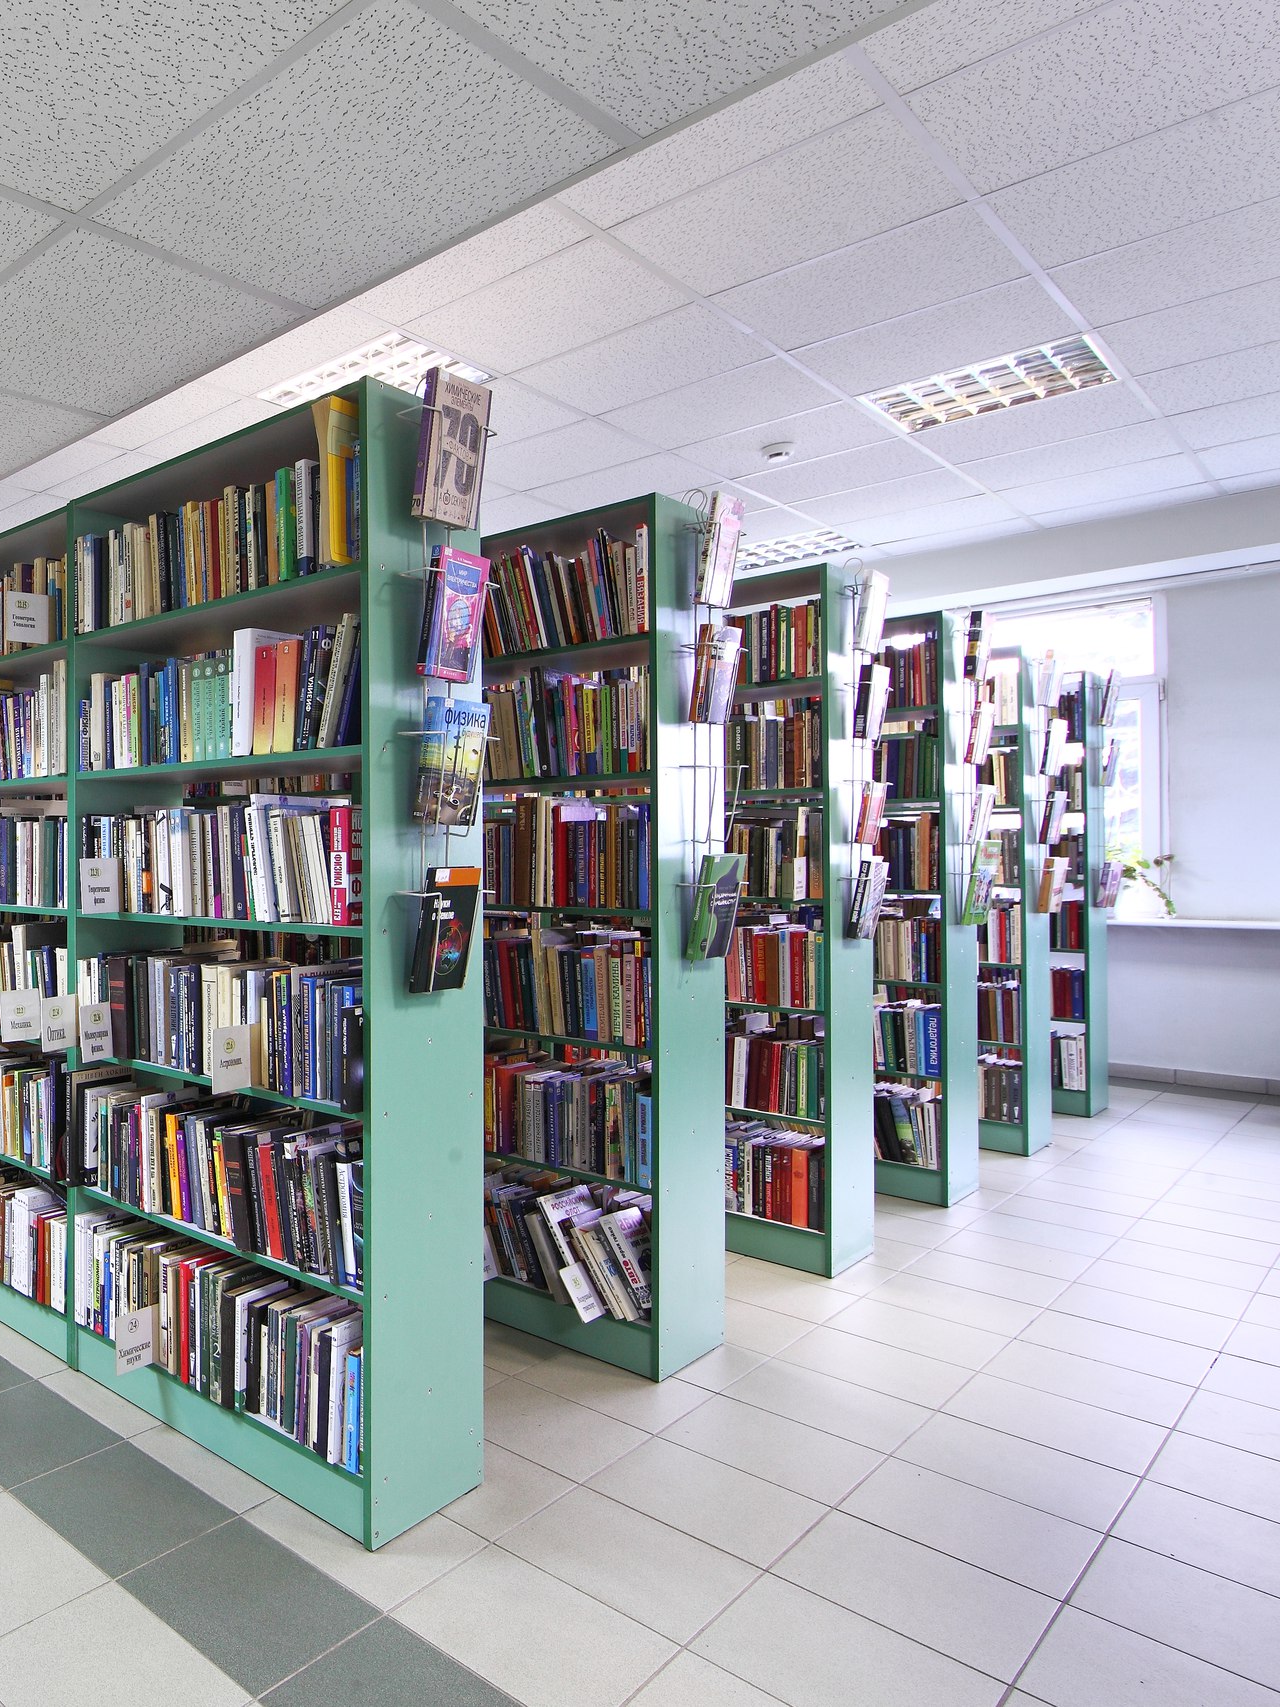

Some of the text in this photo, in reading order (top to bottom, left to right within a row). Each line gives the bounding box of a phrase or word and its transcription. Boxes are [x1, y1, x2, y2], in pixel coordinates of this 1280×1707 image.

[445, 382, 481, 406] ХИМИЧЕСКИЕ
[451, 396, 473, 411] ЭЛЕМЕНТЫ
[434, 404, 481, 496] 70
[296, 465, 304, 524] УДИВИТЕЛЬНАЯ
[411, 499, 421, 508] 70
[312, 630, 319, 640] 11
[305, 676, 314, 712] ФИЗИКА
[81, 700, 89, 772] ОСНОВЫ ФИЗИКИ
[333, 853, 342, 886] ФИЗИКА
[333, 909, 341, 920] ЕГЭ
[612, 960, 620, 1000] КАМИНЫ
[10, 1020, 32, 1030] Механика.
[613, 1008, 621, 1033] ПЕЧИ
[46, 1026, 66, 1042] Оптика.
[928, 1017, 939, 1065] педагогика
[338, 1168, 348, 1218] Астрономия
[725, 1175, 734, 1199] РОССИИ
[551, 1194, 587, 1210] РОССИЙСКИЙ
[564, 1207, 581, 1216] ФЛОТ
[129, 1320, 138, 1331] 24
[118, 1340, 151, 1359] Химические
[213, 1343, 220, 1358] 2
[126, 1354, 142, 1366] науки
